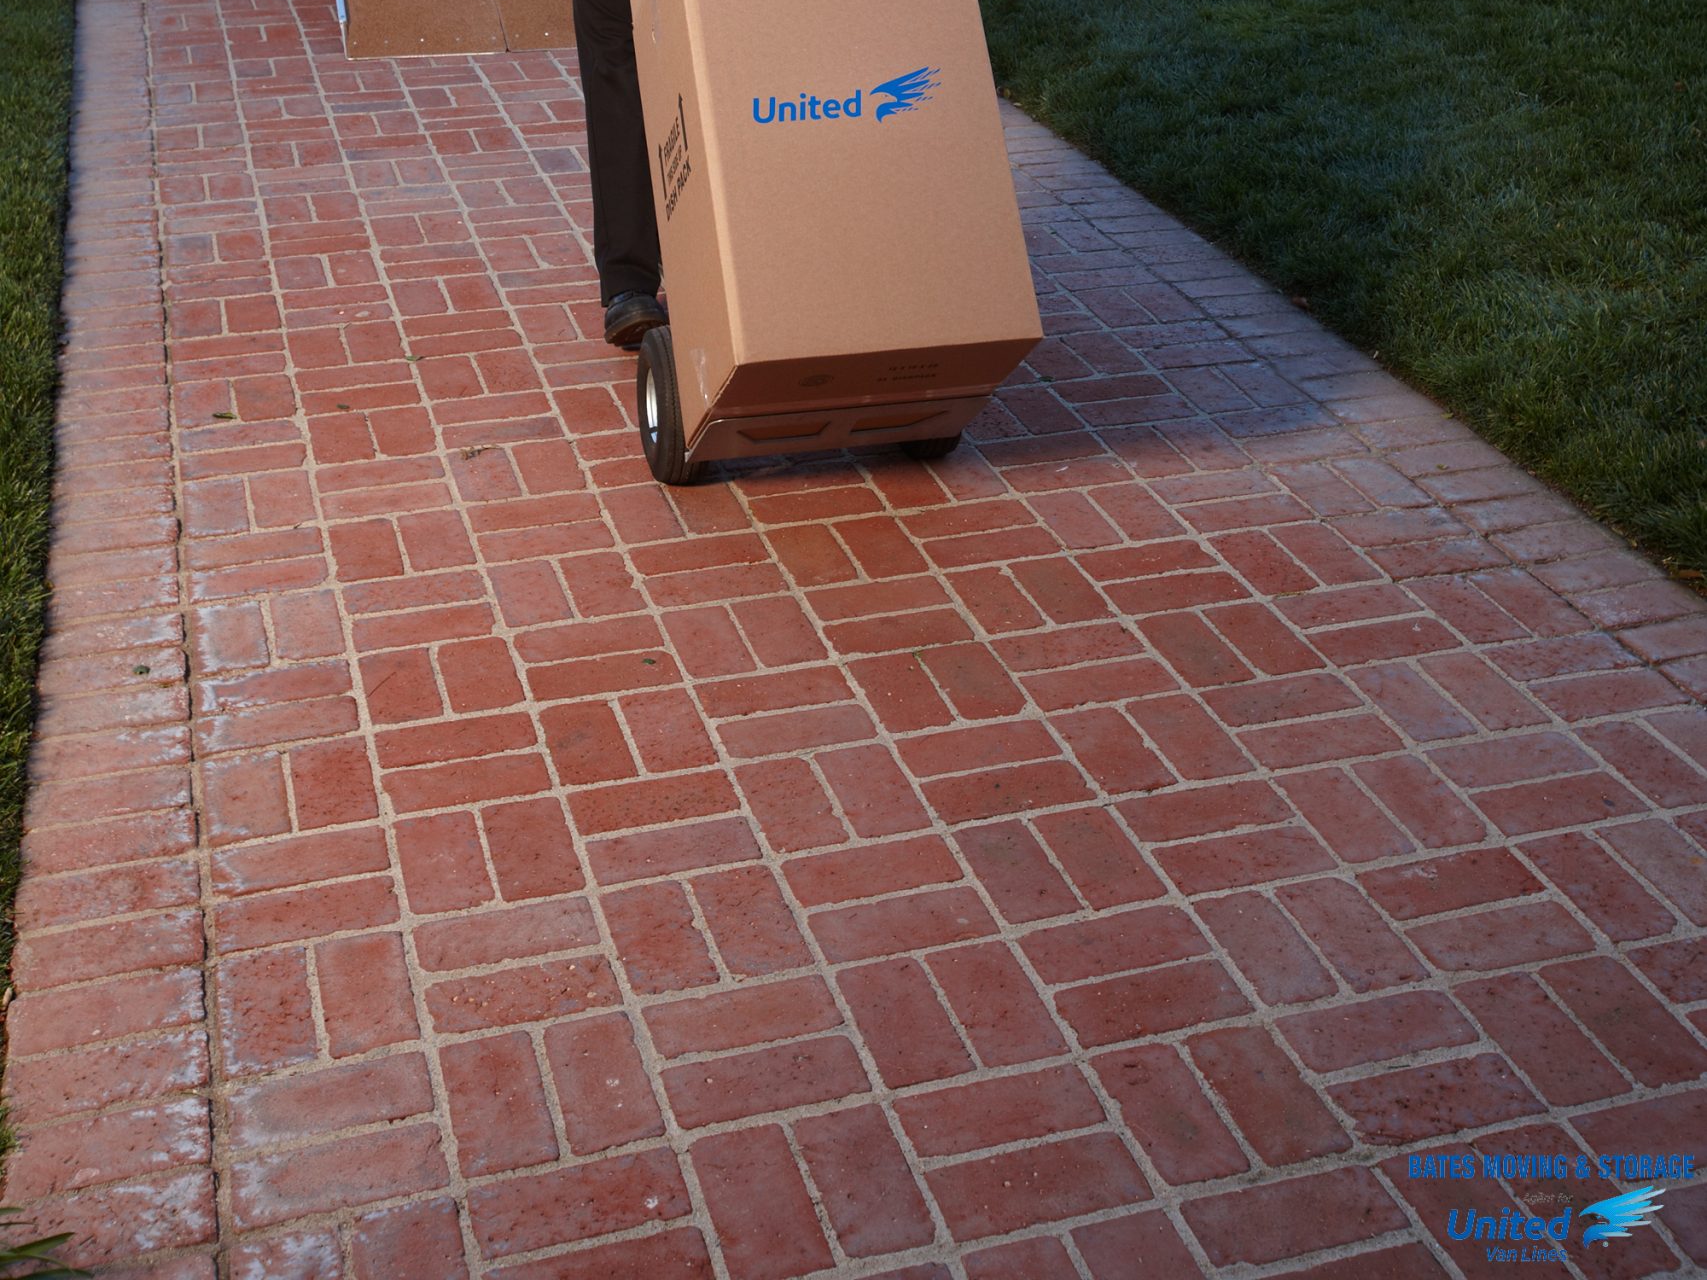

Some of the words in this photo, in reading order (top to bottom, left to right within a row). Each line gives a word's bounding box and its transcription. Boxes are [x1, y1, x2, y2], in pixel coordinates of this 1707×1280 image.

[753, 89, 862, 124] United
[664, 116, 680, 166] FRAGILE
[666, 186, 678, 221] DISH
[677, 155, 692, 196] PACK
